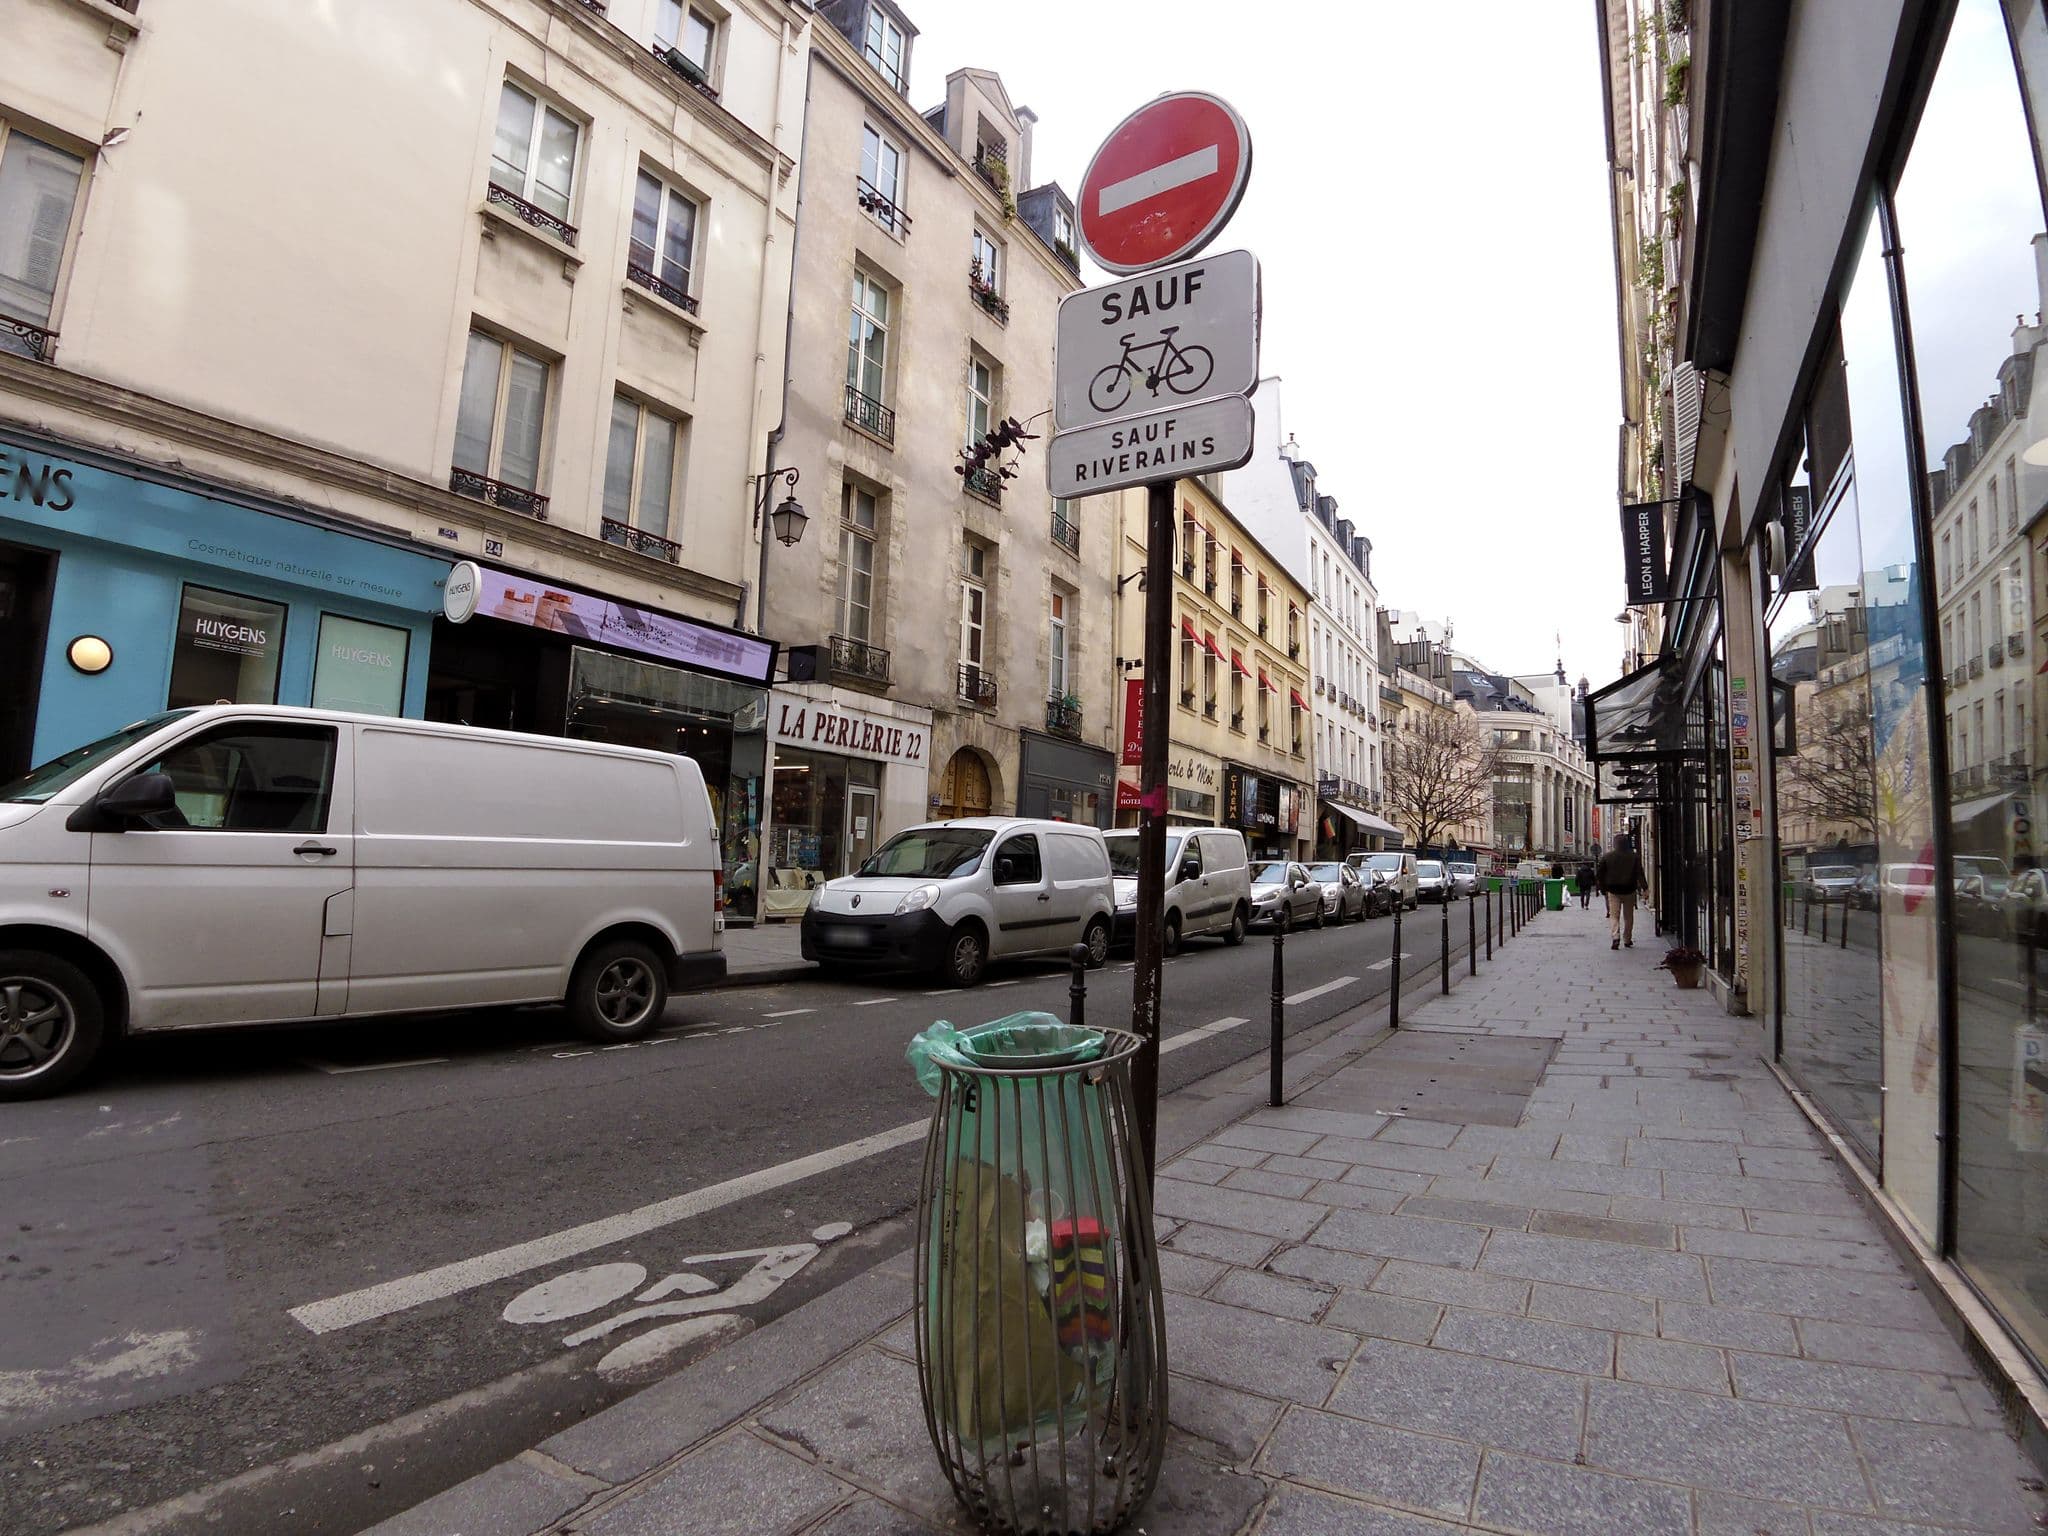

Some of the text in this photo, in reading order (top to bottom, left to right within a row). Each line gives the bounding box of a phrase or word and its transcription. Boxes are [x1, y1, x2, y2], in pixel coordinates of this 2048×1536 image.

[1101, 269, 1205, 325] SAUF
[1111, 419, 1177, 449] SAUF
[1075, 437, 1215, 482] RIVERAINS
[486, 541, 502, 556] 24
[1639, 512, 1651, 555] HARPER
[188, 539, 402, 598] Cosmétique naturelle sur mesure
[1641, 566, 1653, 595] LEON
[196, 618, 266, 645] HUYGENS
[332, 644, 392, 667] HUYGENS
[778, 704, 921, 760] LA PERLERIE 22
[1187, 758, 1194, 779] &
[1197, 763, 1215, 786] Moi
